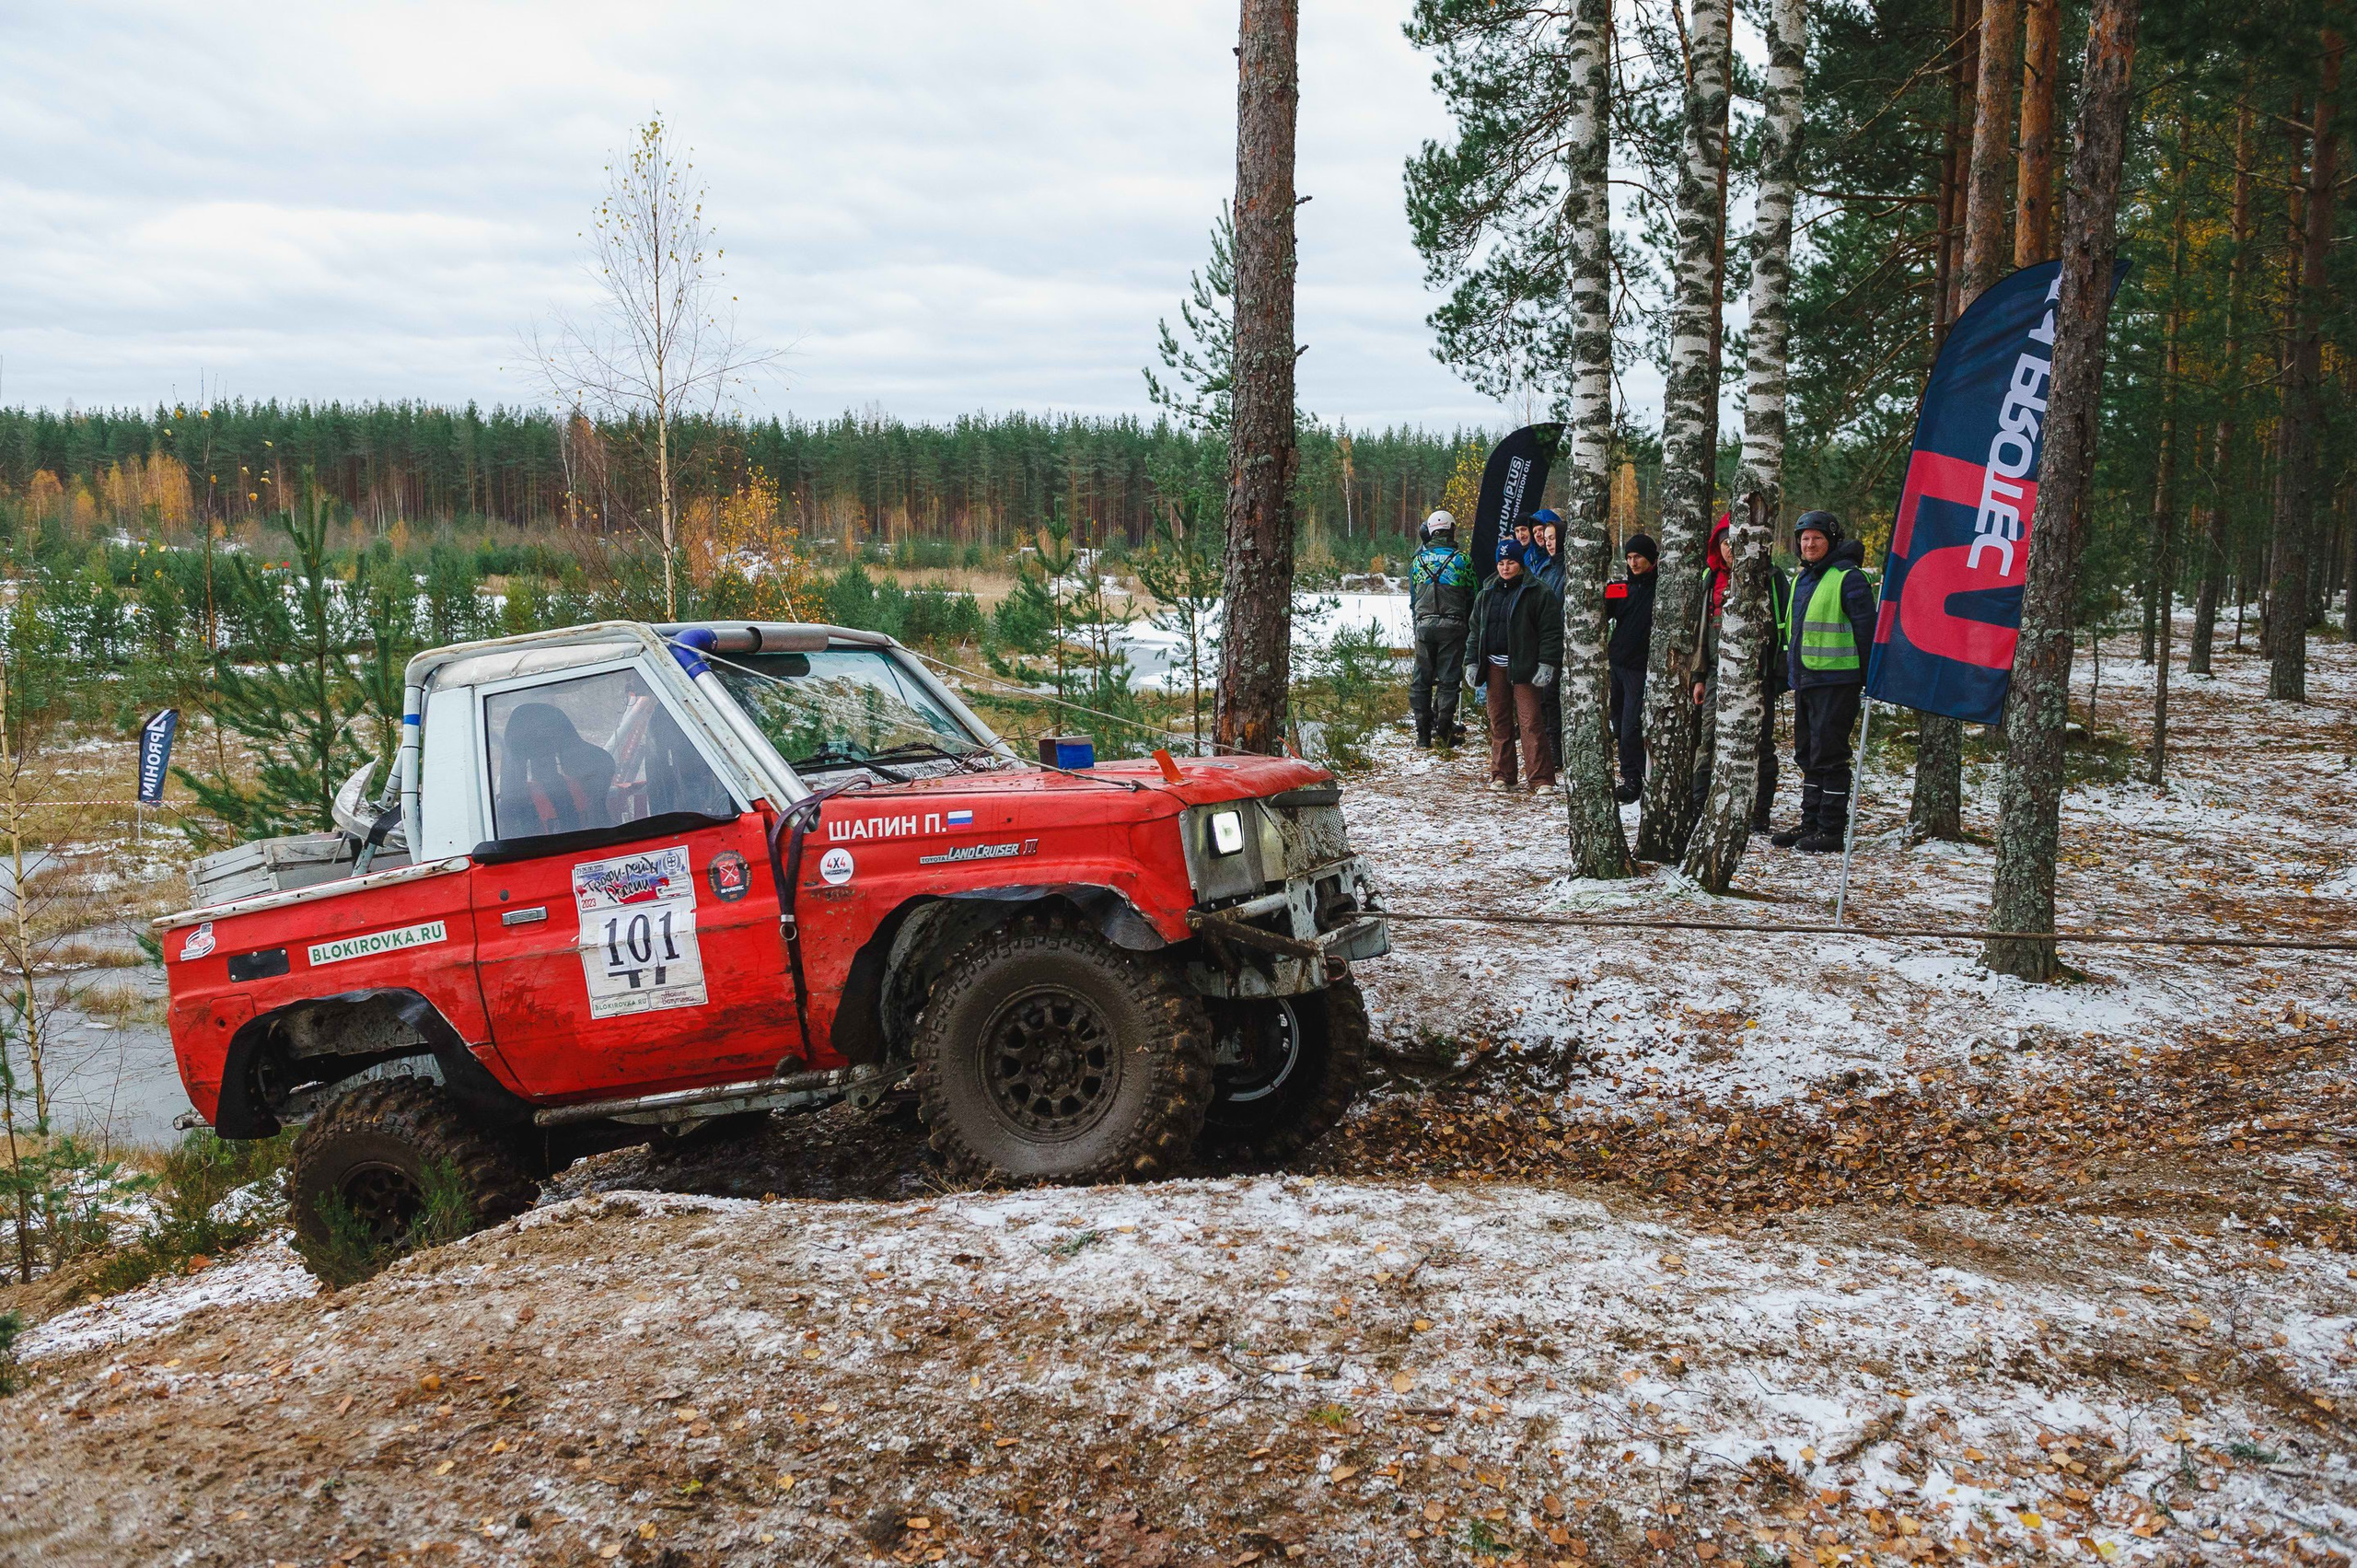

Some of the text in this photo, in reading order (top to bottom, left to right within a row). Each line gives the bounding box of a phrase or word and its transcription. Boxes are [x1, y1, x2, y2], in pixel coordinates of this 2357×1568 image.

[1524, 459, 1532, 472] OIL
[1505, 459, 1522, 496] PLUS
[828, 812, 947, 842] ШАПИН П.
[921, 855, 946, 864] TOYOTA
[581, 898, 597, 909] 2023
[312, 924, 442, 962] BLOKIROVKA.RU
[604, 911, 680, 967] 101
[595, 998, 647, 1011] BLOKIROVKA.RU
